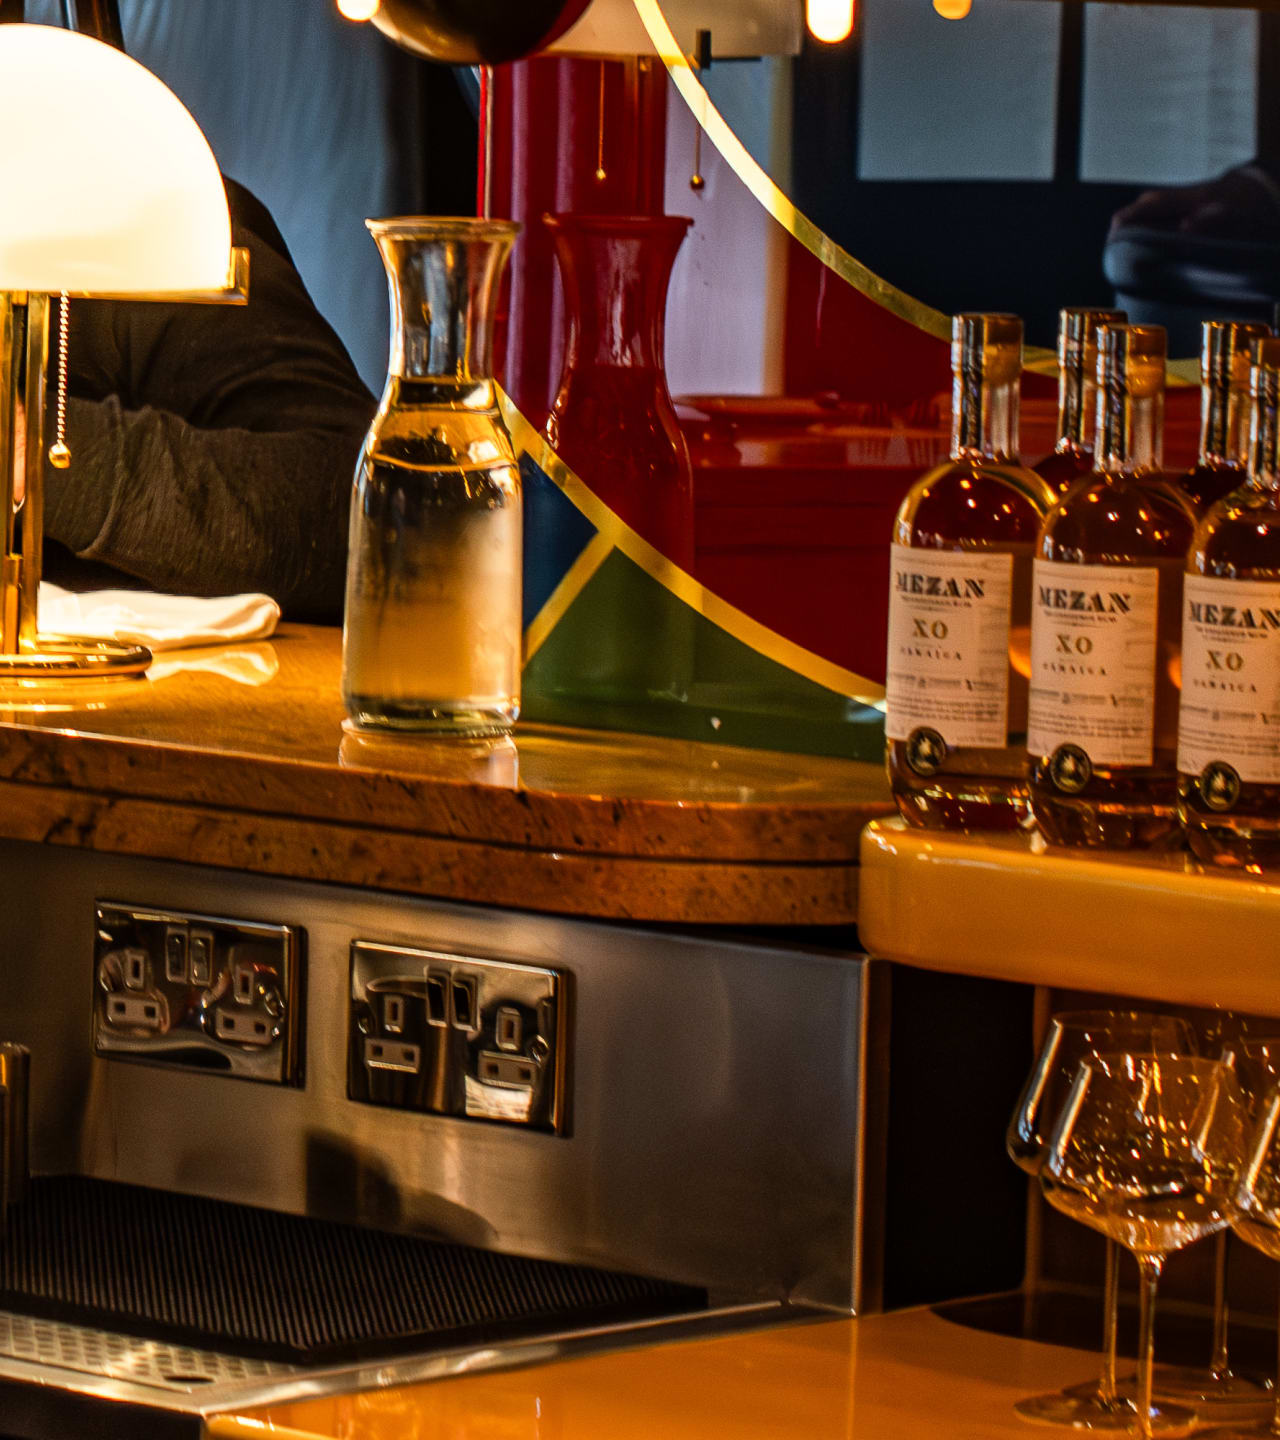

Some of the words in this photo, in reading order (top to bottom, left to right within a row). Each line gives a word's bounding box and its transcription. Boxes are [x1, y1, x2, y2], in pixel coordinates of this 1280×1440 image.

[895, 571, 986, 600] MEZAN
[1038, 584, 1131, 615] MEZAN
[912, 617, 949, 641] XO
[1055, 633, 1094, 656] XO
[1205, 649, 1244, 672] XO
